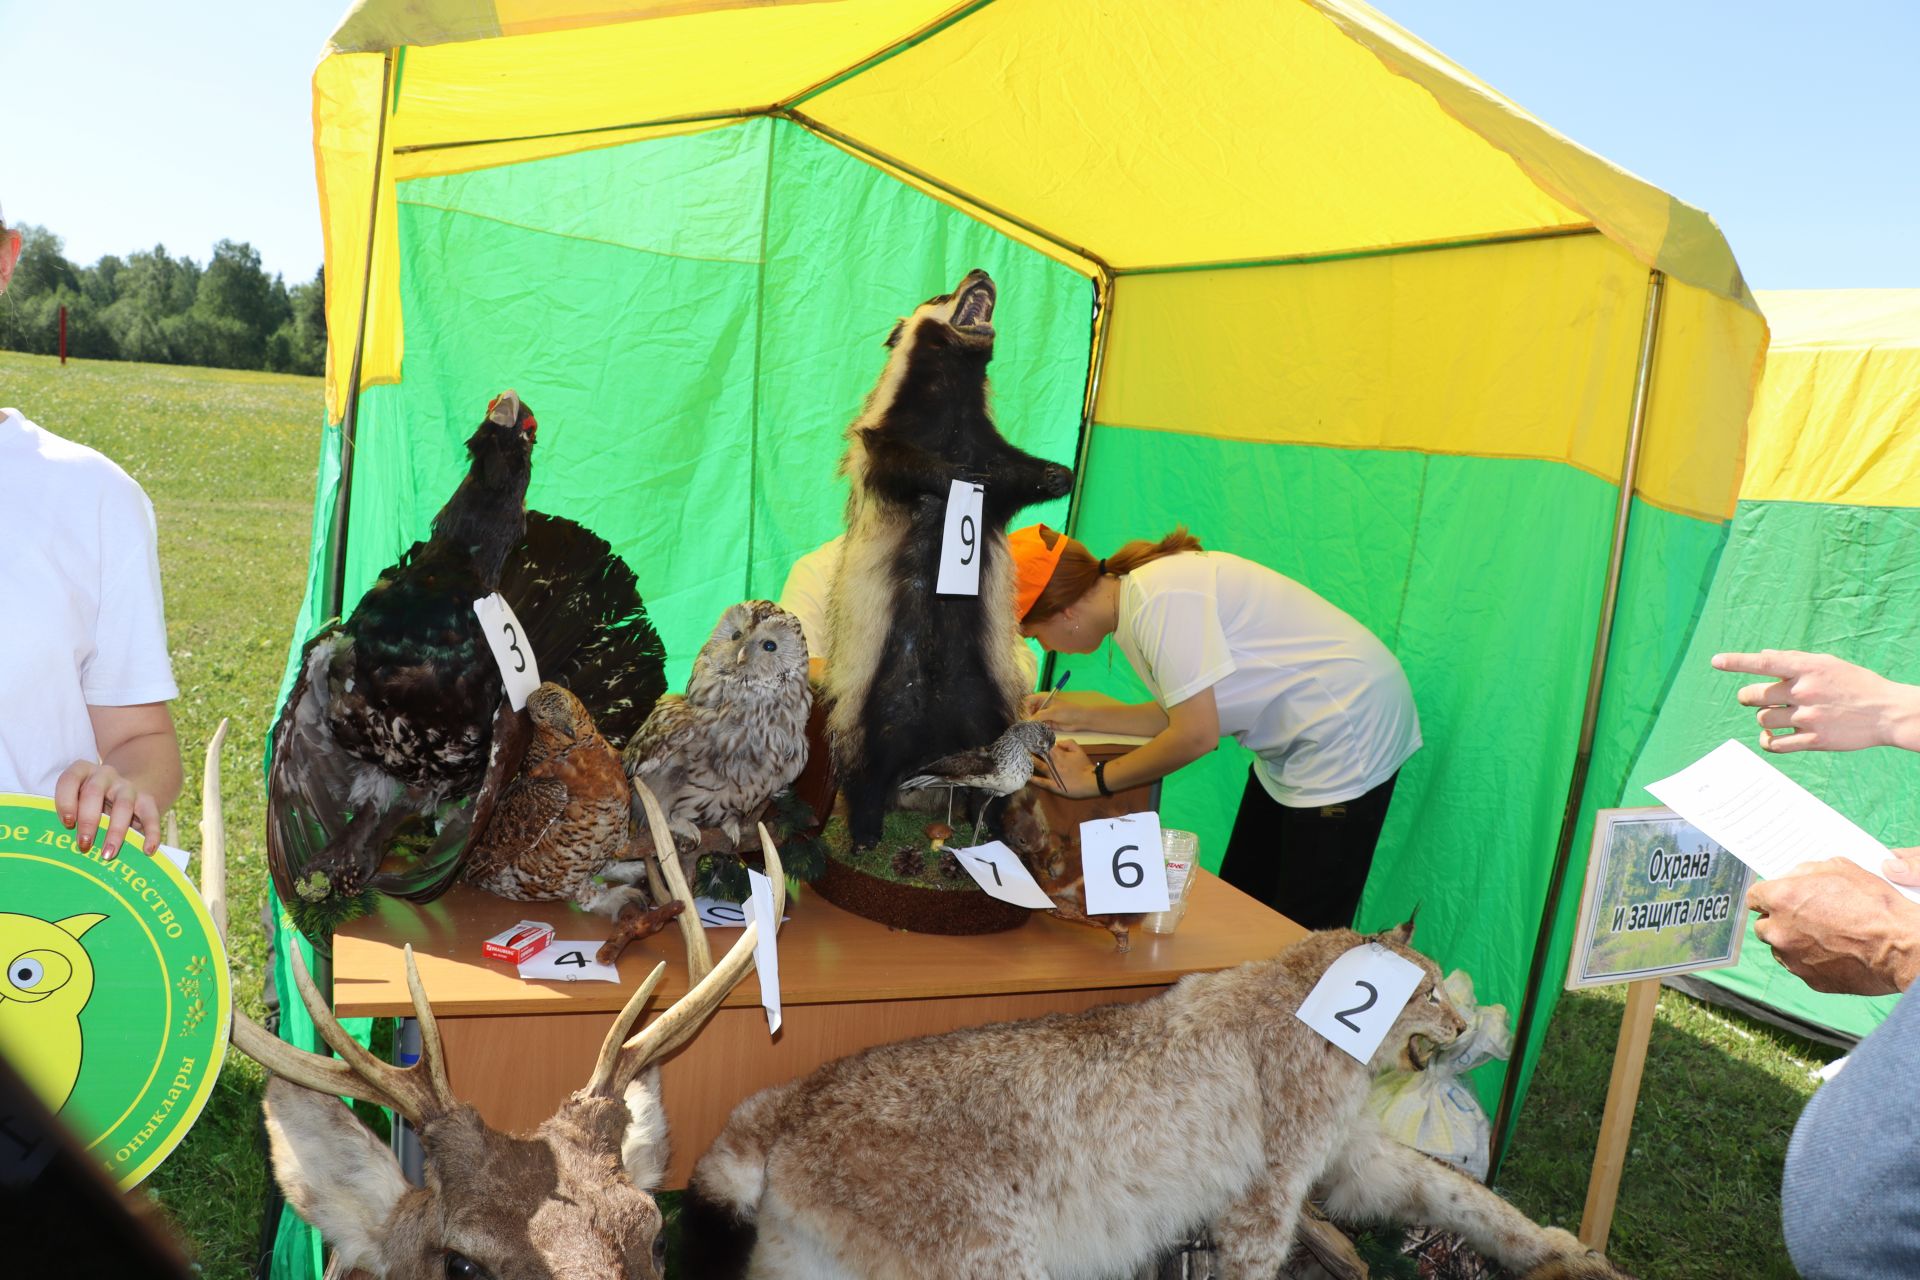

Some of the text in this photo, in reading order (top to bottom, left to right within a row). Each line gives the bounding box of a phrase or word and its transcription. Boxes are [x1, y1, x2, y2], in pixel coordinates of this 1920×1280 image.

[961, 515, 975, 566] 9
[503, 622, 526, 673] 3
[1112, 845, 1144, 888] 6
[1648, 848, 1711, 890] Охрана
[1611, 895, 1731, 934] и защита леса
[554, 951, 593, 969] 4
[1334, 980, 1378, 1034] 2
